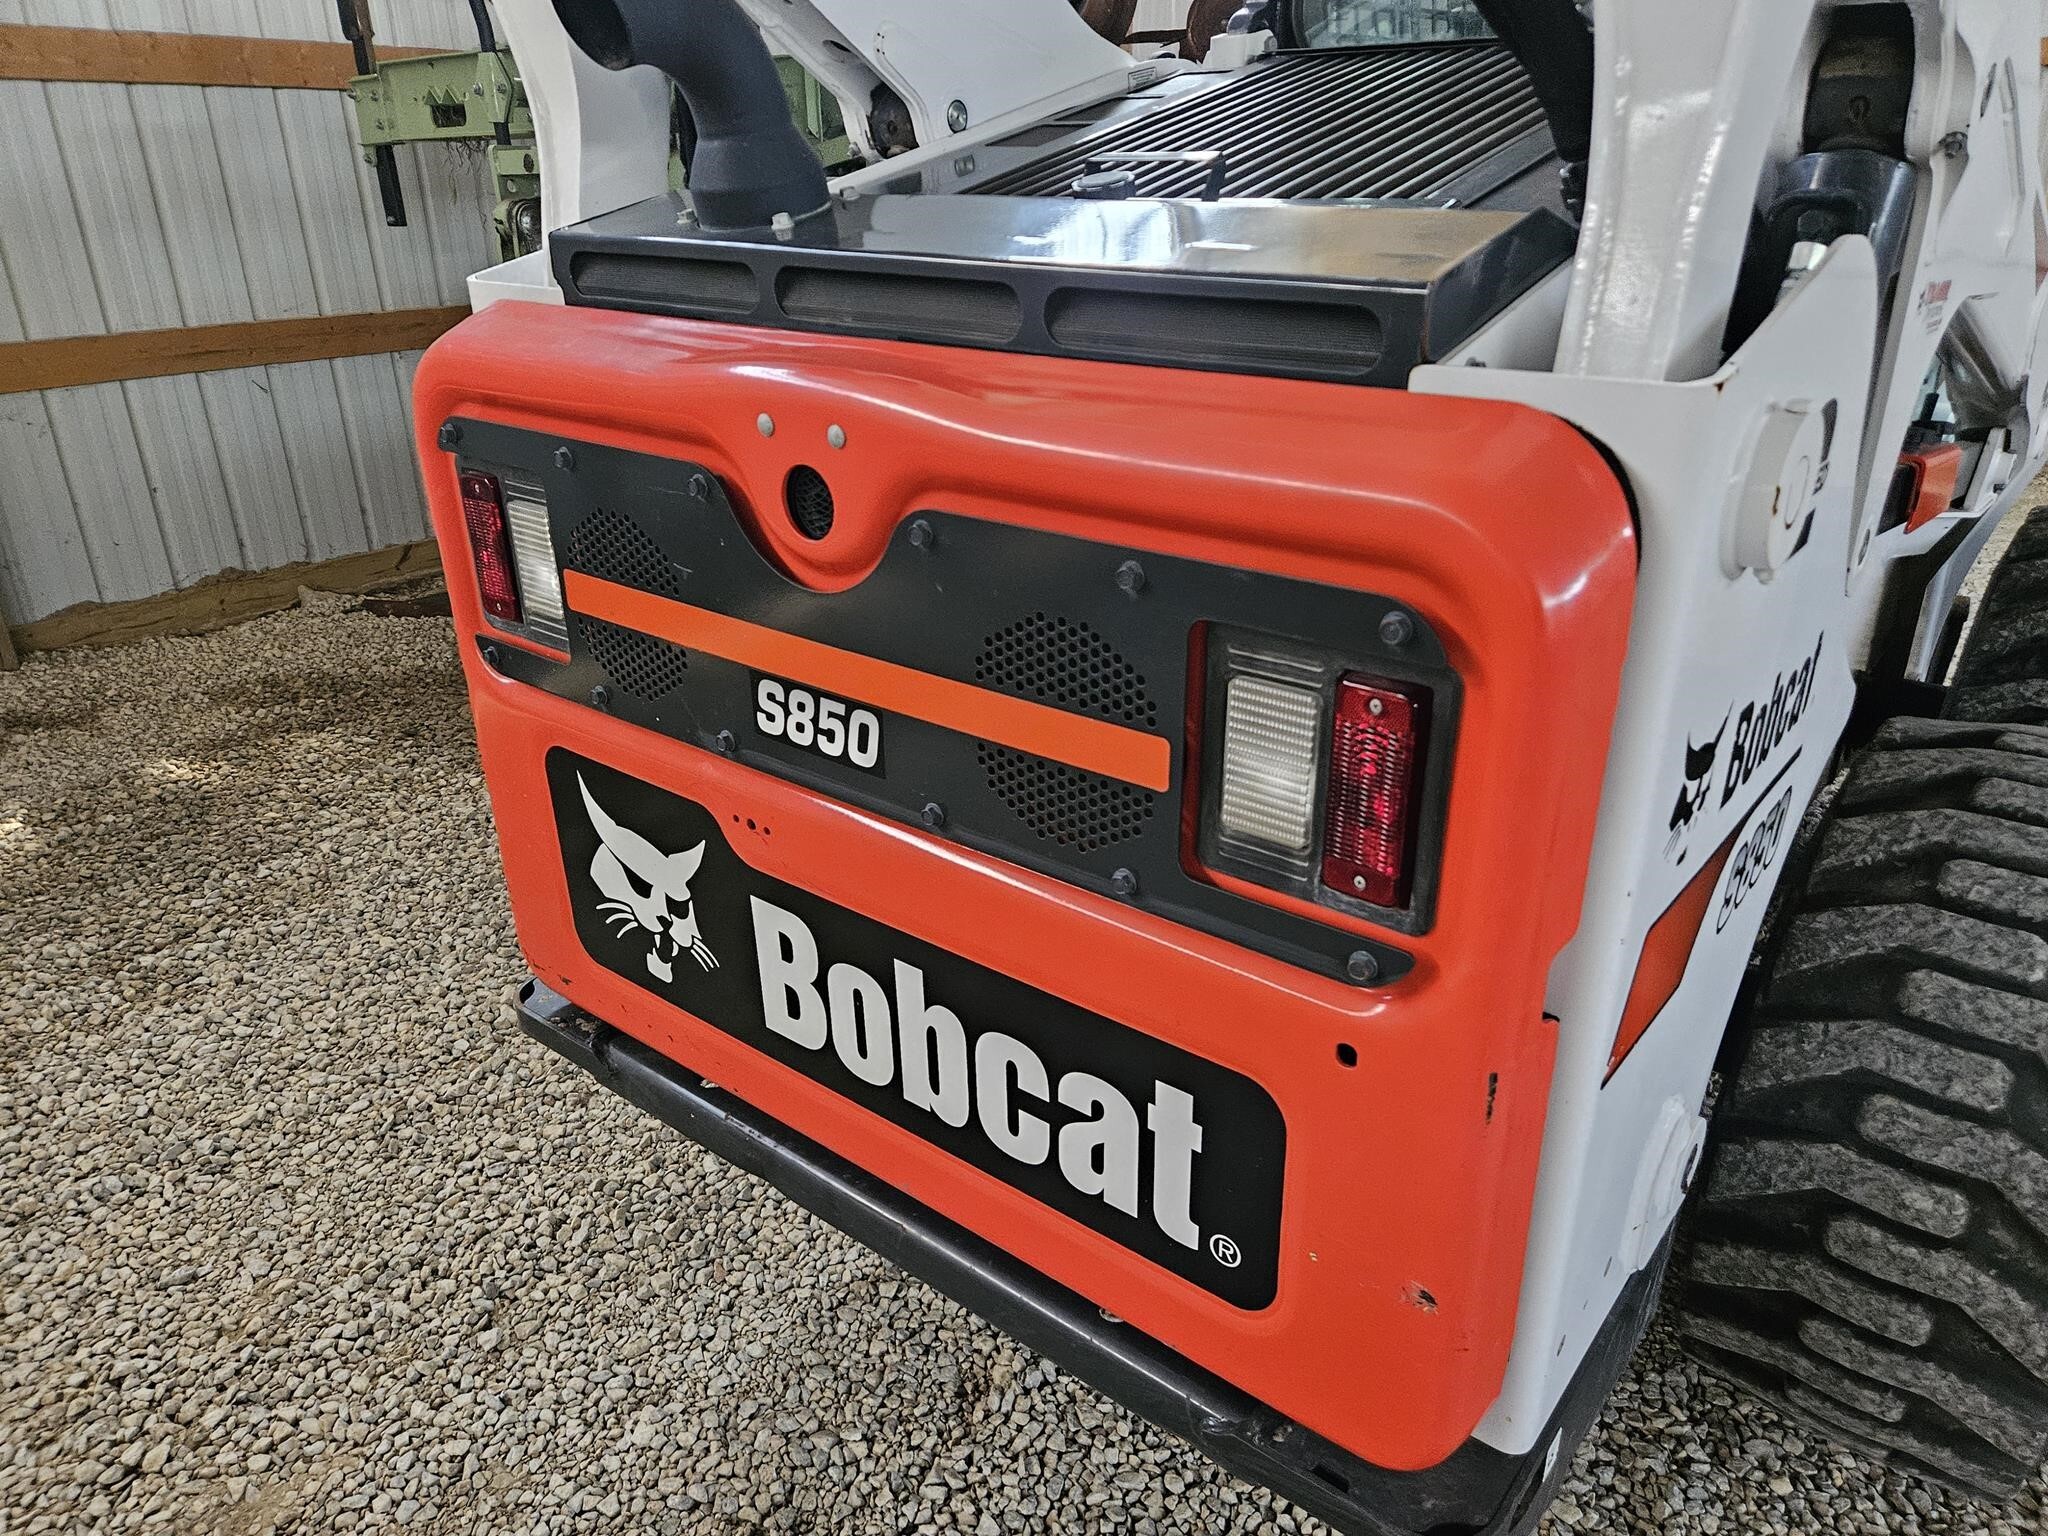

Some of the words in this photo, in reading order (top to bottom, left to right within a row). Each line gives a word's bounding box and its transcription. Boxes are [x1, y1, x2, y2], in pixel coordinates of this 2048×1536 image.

[756, 679, 880, 768] S850
[1719, 630, 1824, 810] Bobcat
[749, 894, 1203, 1251] Bobcat
